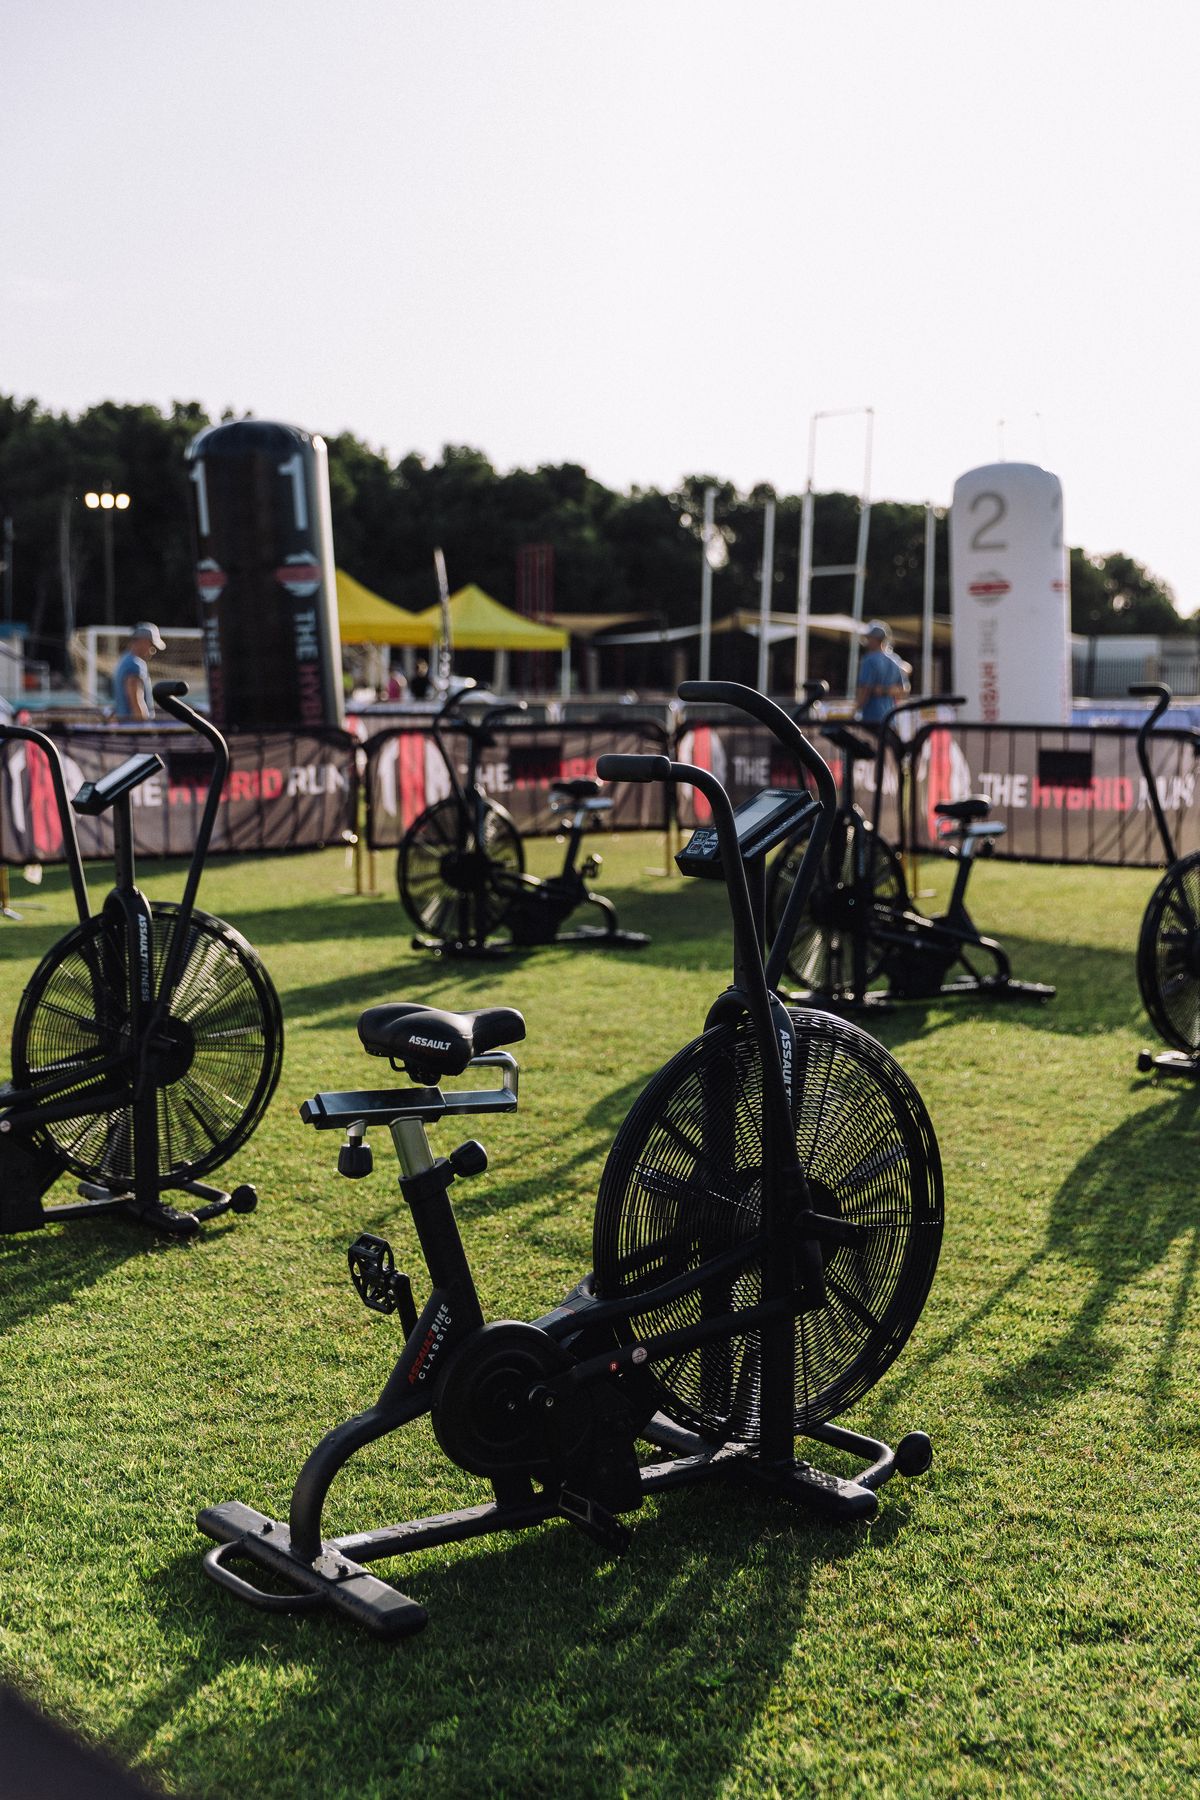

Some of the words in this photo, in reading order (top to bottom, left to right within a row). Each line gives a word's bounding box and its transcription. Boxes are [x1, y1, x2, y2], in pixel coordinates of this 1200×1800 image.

[279, 453, 308, 531] 1
[970, 491, 1007, 552] 2
[295, 609, 319, 662] THE
[287, 764, 349, 798] RUN
[474, 762, 513, 793] HE
[733, 756, 770, 786] THE
[978, 772, 1028, 808] THE
[408, 1035, 451, 1051] ASSAULT
[780, 1029, 792, 1109] ASSAULT
[418, 1316, 451, 1379] CLASSIC
